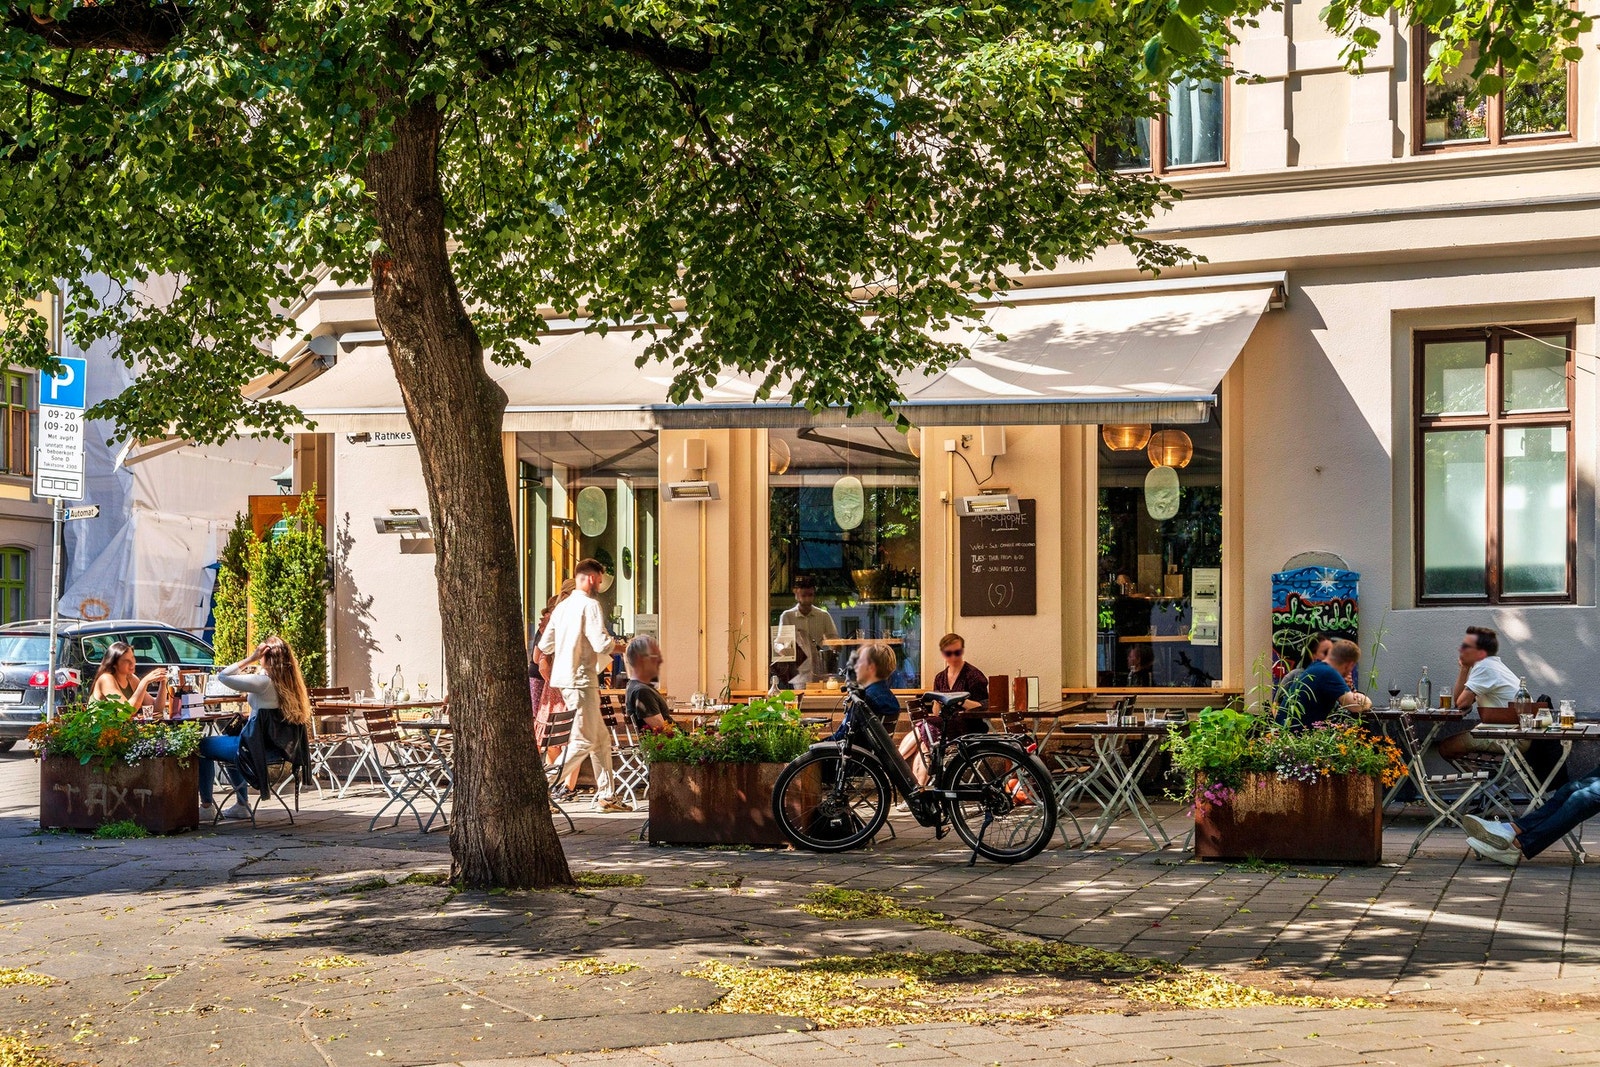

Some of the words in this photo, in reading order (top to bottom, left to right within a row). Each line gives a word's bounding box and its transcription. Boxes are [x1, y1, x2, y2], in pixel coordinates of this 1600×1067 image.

[51, 363, 75, 399] P
[374, 431, 412, 441] Rathkes
[71, 509, 94, 518] Automat
